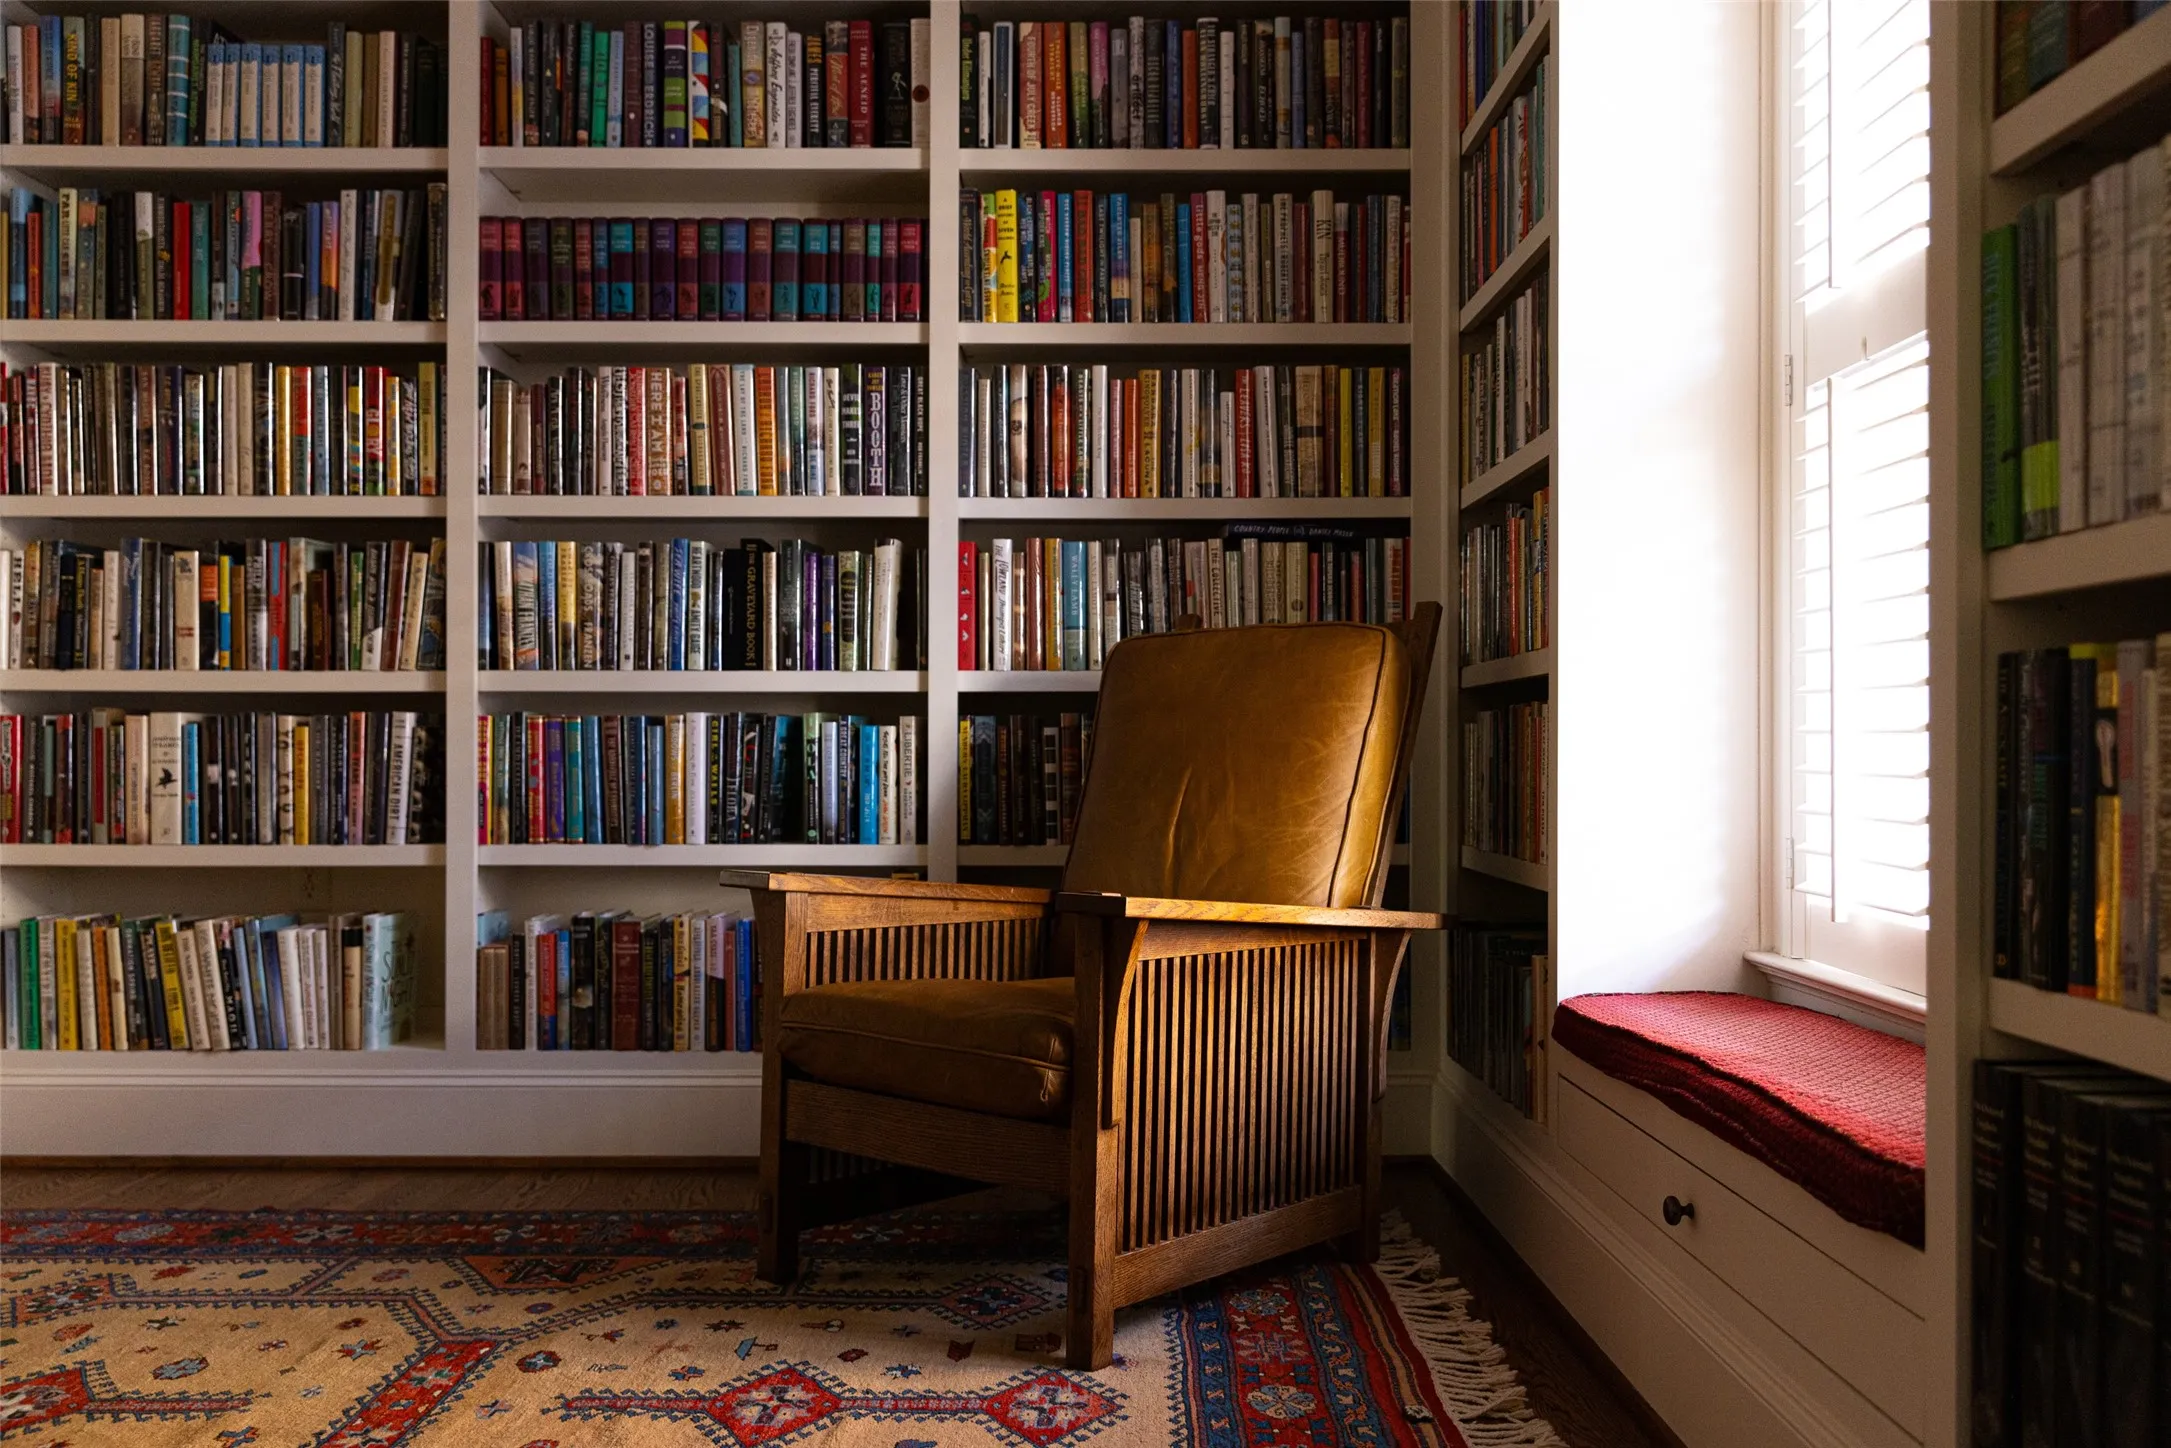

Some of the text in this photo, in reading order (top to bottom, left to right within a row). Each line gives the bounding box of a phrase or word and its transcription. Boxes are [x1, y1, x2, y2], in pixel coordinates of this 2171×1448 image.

[645, 23, 655, 138] LOUISE ERDRICH
[1316, 219, 1332, 241] KIN
[651, 372, 662, 453] HERE I AM
[869, 392, 883, 487] BOOTH
[690, 546, 702, 588] HEARTWOOD
[1211, 567, 1221, 617] COLLECTIVE
[746, 567, 757, 630] GRAVEYARD
[584, 621, 594, 669] FRANZEN
[746, 632, 757, 660] BOOK
[903, 731, 913, 778] LIBERTIE
[389, 743, 404, 821] AMERICAN DIRT
